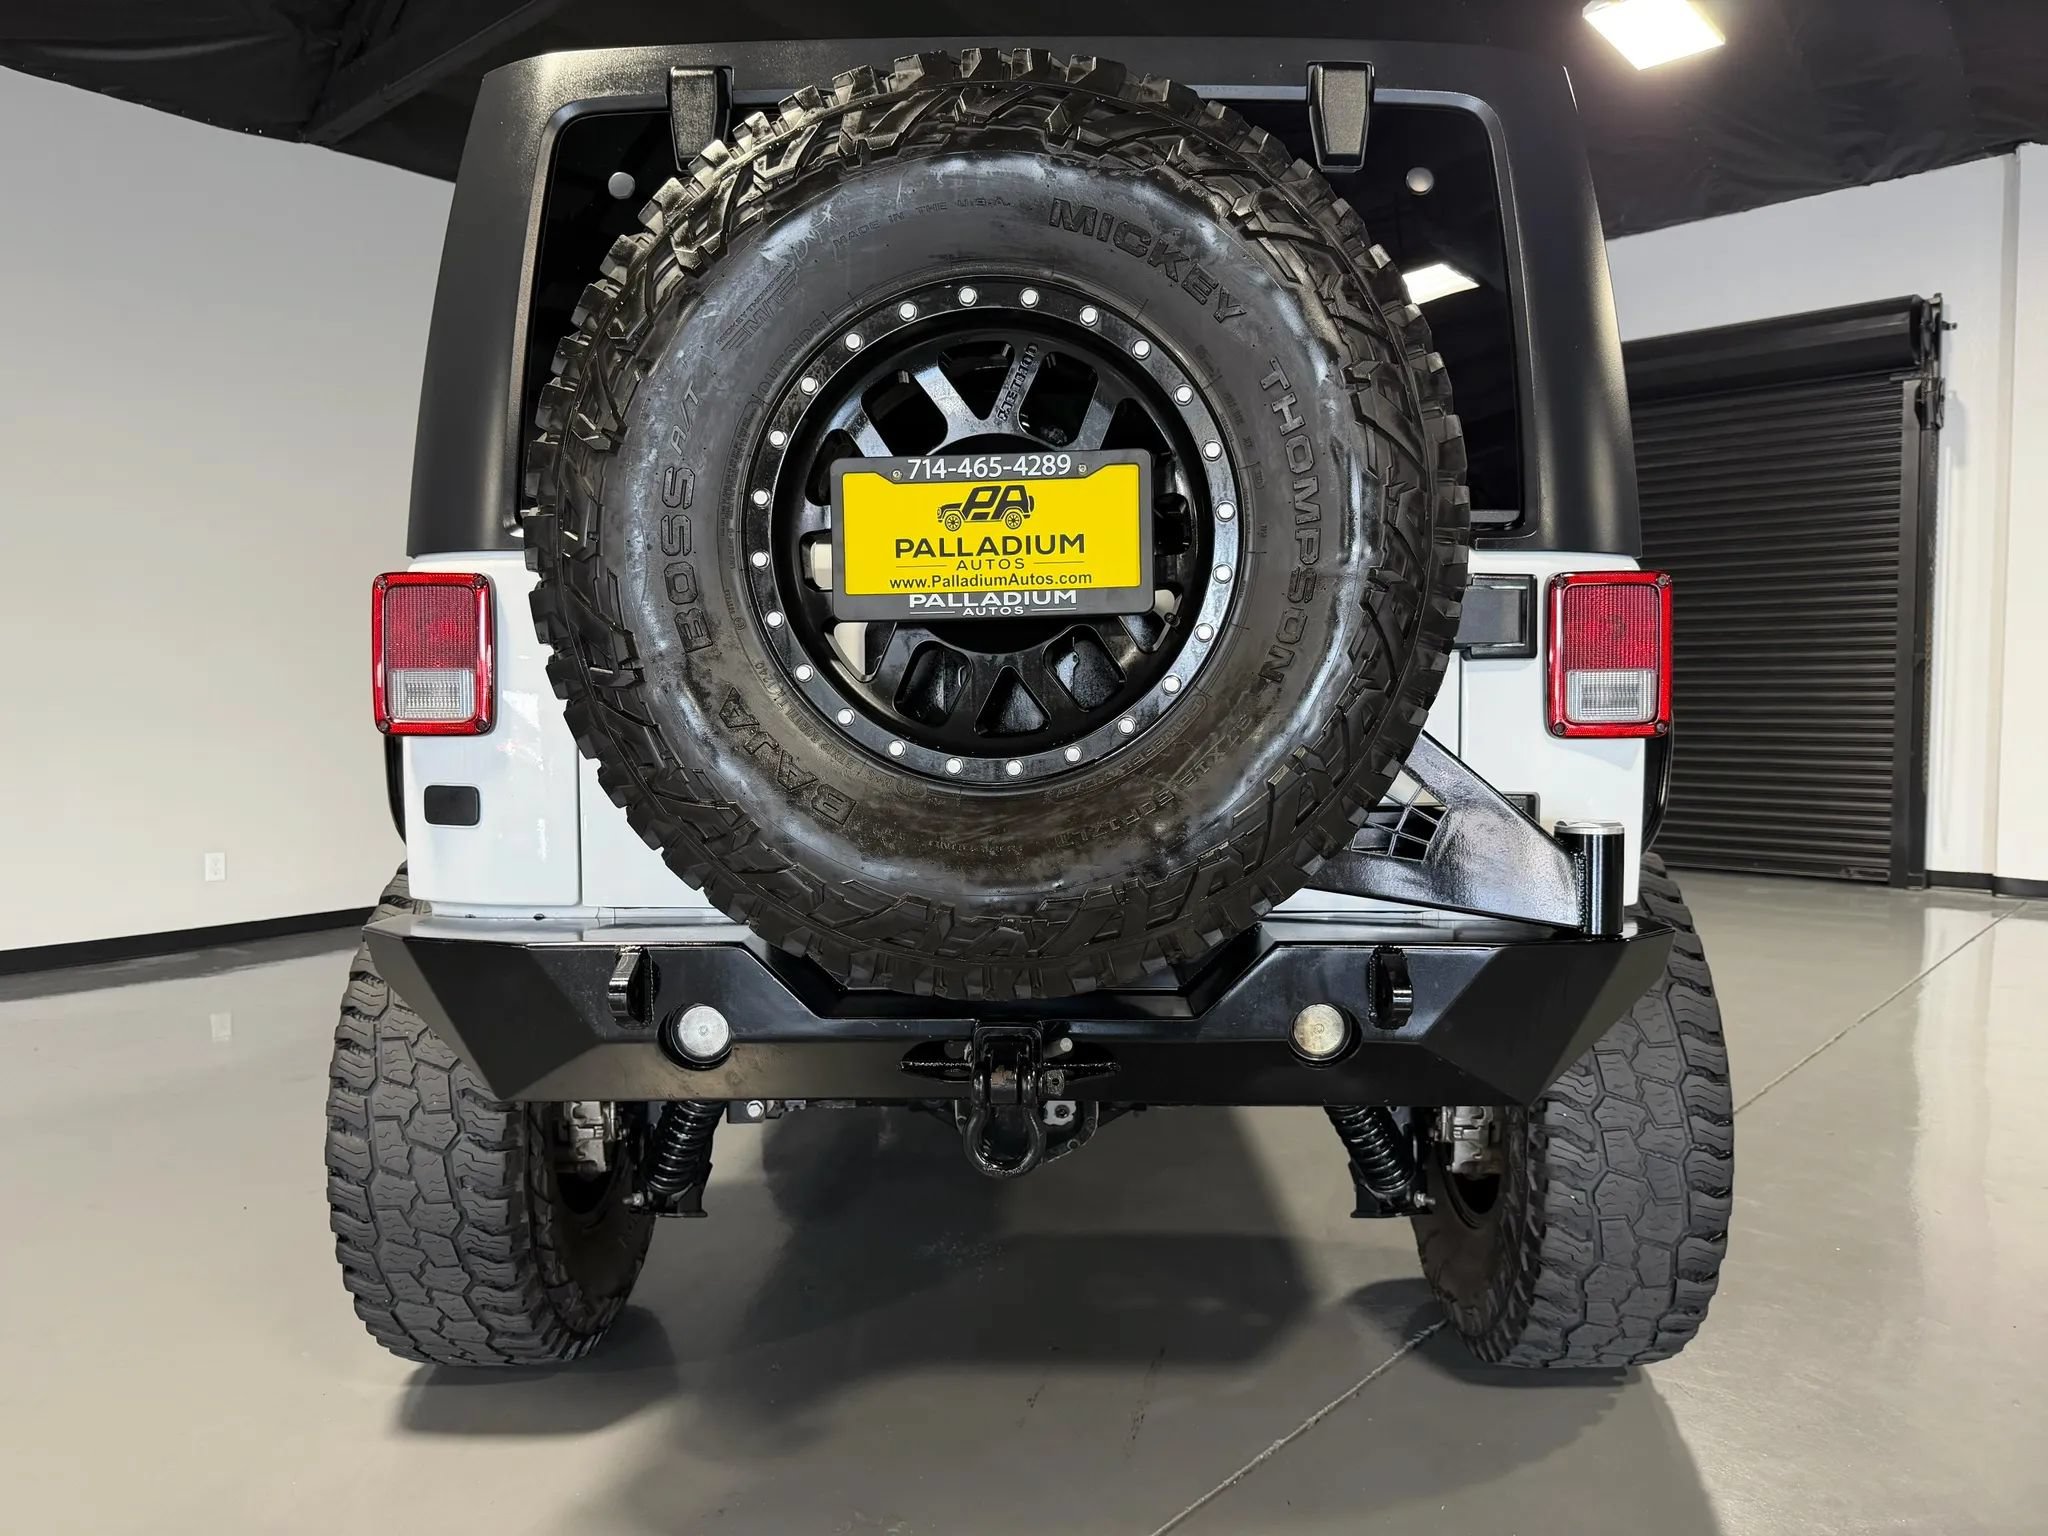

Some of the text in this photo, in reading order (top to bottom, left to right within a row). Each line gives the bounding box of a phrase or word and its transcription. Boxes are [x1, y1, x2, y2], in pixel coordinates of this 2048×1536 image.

[832, 219, 881, 248] MADE
[888, 211, 906, 224] IN
[915, 202, 949, 216] THE
[757, 317, 824, 396] OUTSIDE
[997, 343, 1039, 422] METHOD
[670, 381, 699, 456] A/T
[1050, 198, 1322, 684] MICKEY THOMPSON
[907, 454, 1071, 480] 714-465-4289
[660, 466, 713, 652] BOSS
[895, 533, 1085, 558] PALLADIUM
[956, 558, 1025, 571] AUTOS
[890, 572, 1092, 589] www.PalladiumAutos.com
[909, 590, 1077, 608] PALLADIUM
[962, 606, 1024, 616] AUTOS
[719, 687, 857, 825] BAJA
